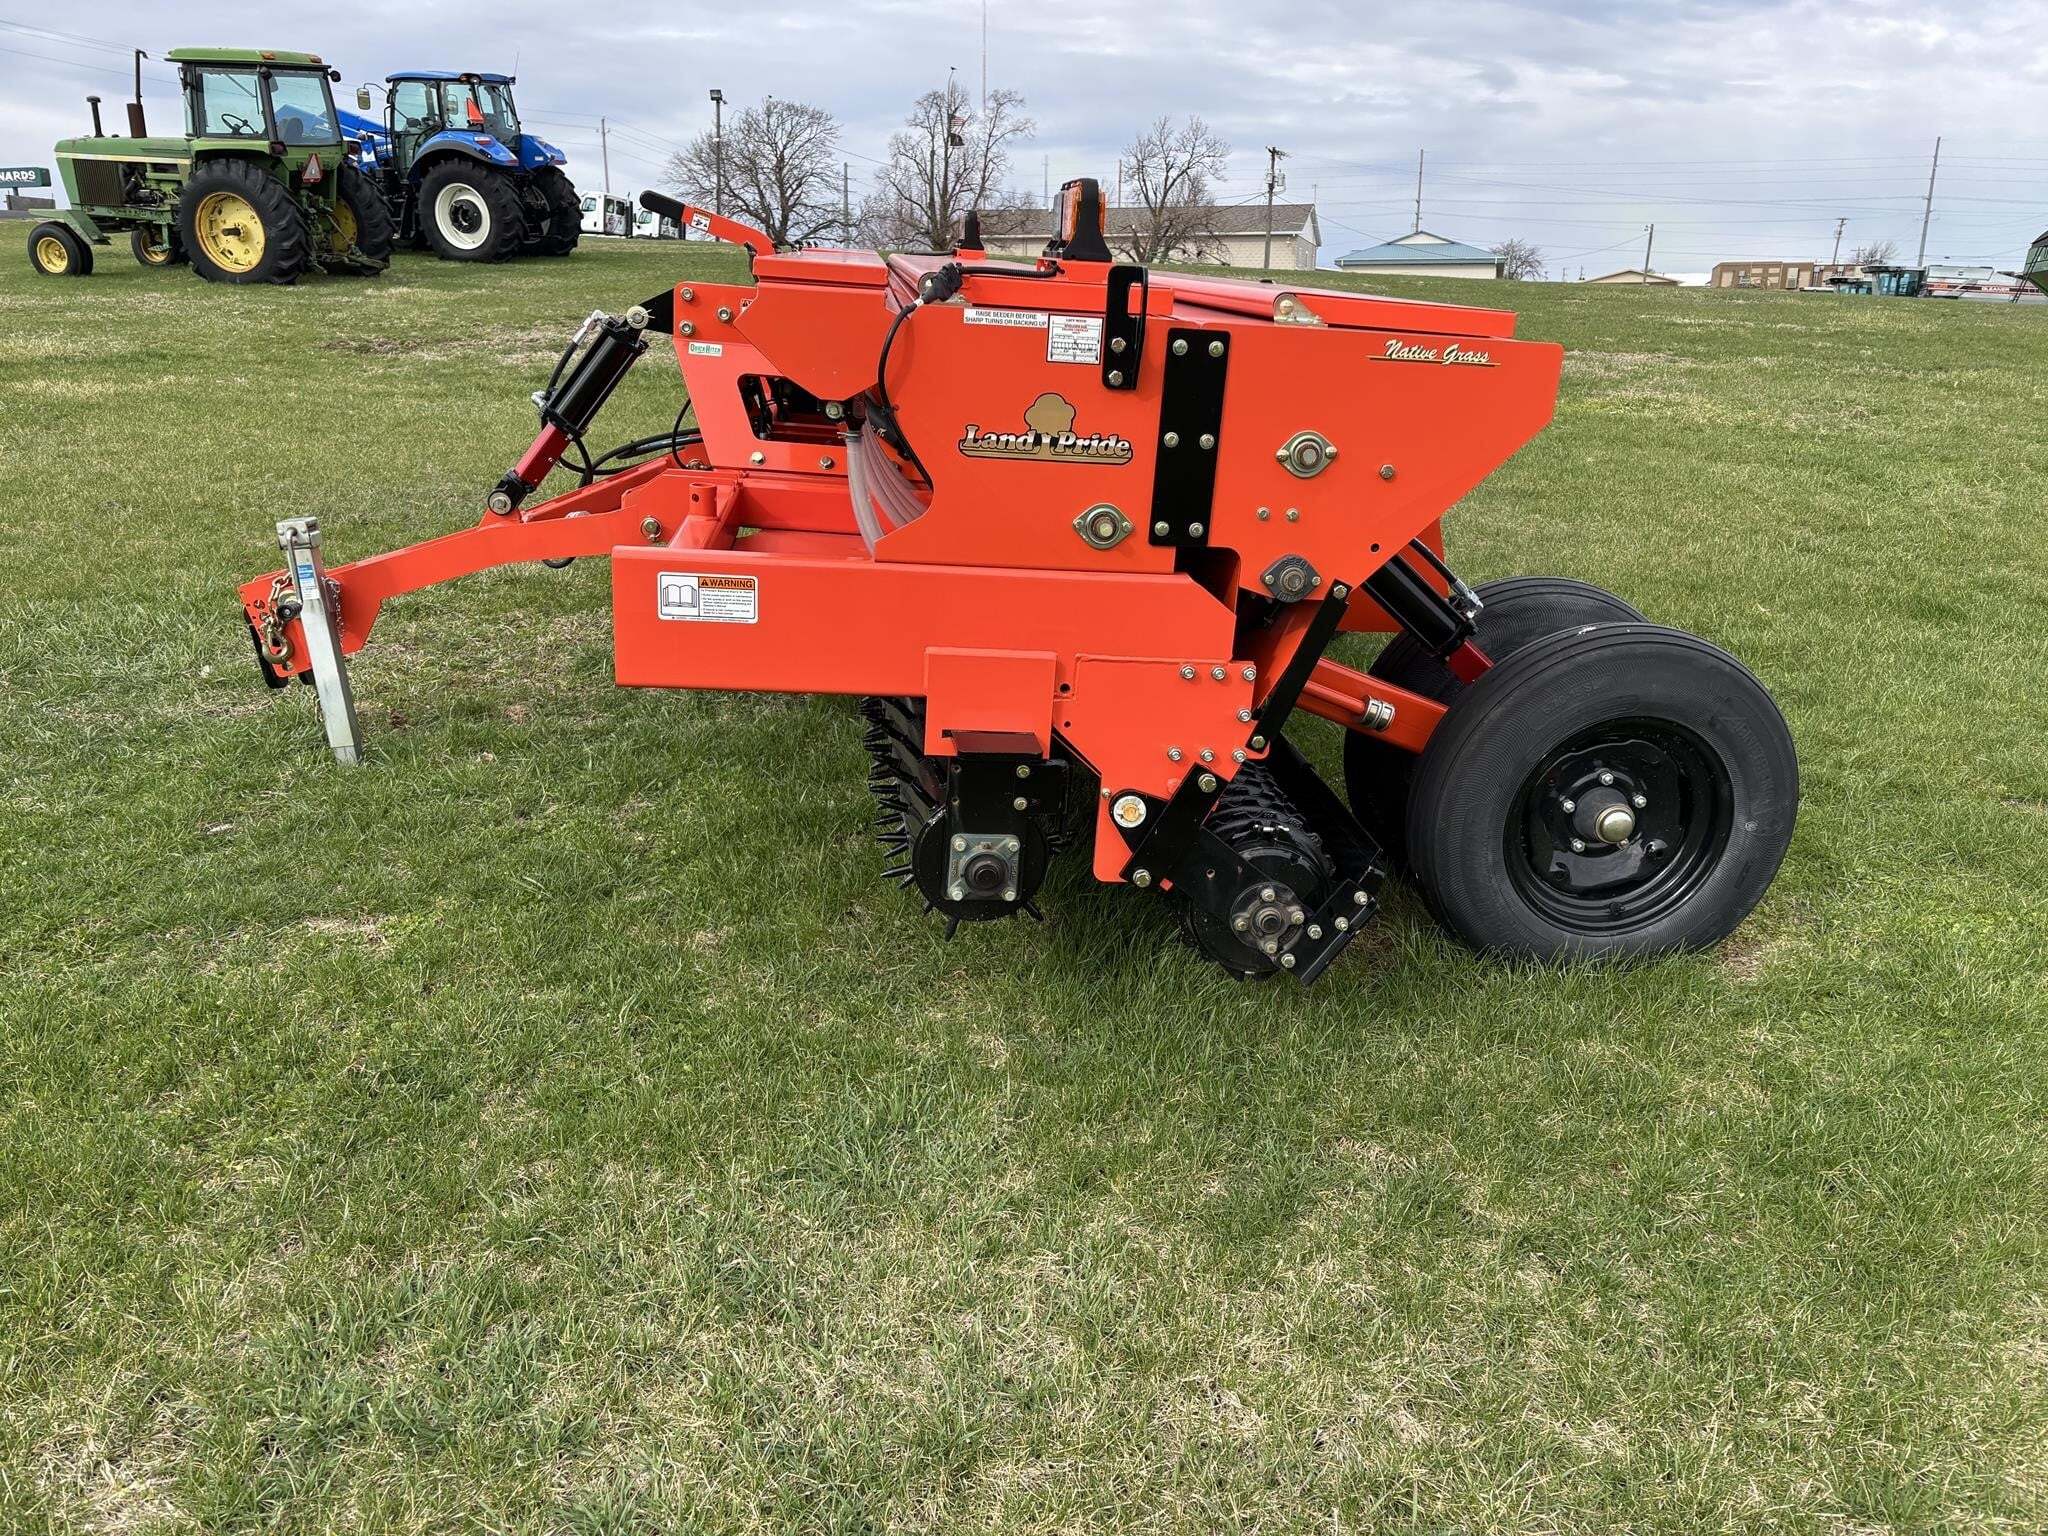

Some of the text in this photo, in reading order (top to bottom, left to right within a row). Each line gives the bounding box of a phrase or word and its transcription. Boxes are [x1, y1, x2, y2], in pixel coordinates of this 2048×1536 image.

[1385, 338, 1490, 365] Native Grass
[963, 425, 1131, 457] Land Pride
[709, 578, 753, 588] WARNING
